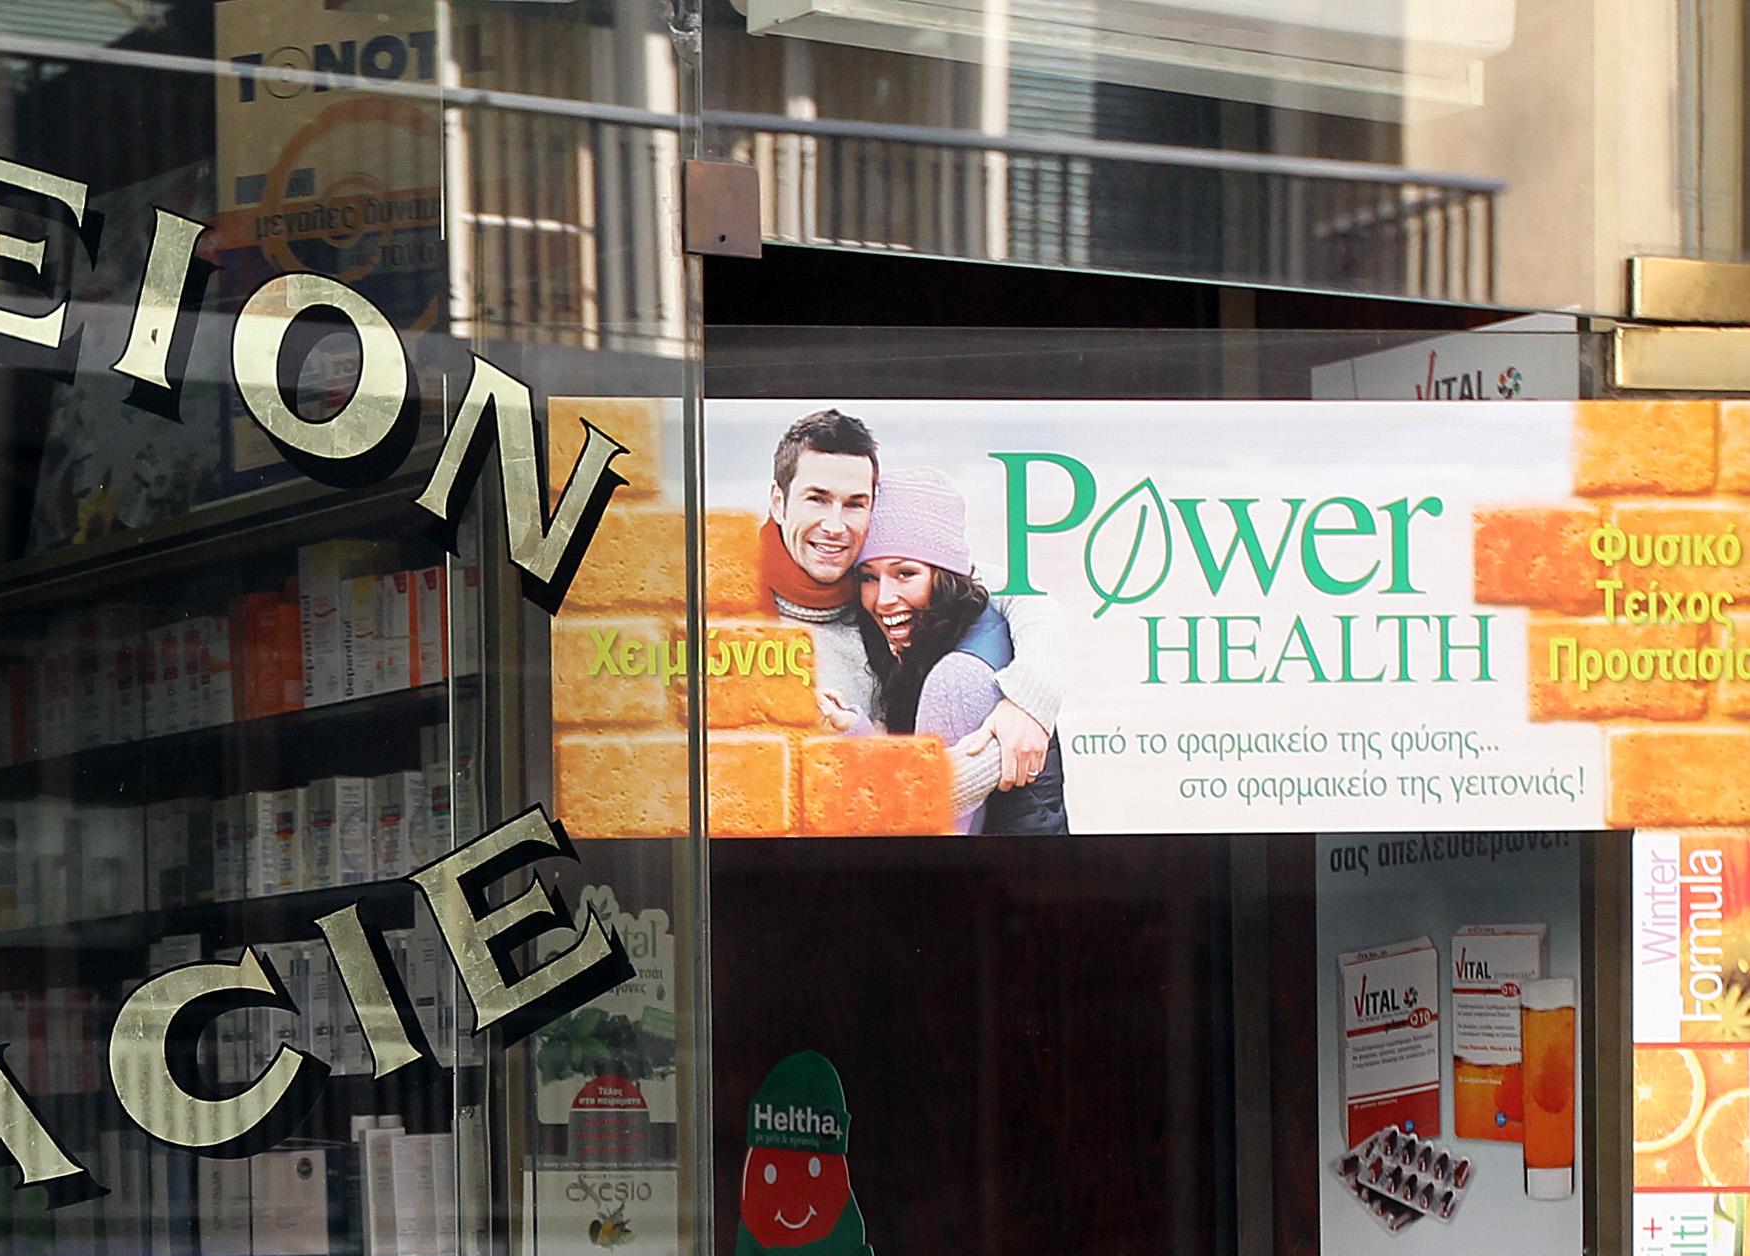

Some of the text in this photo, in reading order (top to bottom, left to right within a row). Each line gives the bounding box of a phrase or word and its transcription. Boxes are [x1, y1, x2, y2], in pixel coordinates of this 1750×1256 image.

[987, 451, 1444, 619] Power
[1589, 522, 1742, 567] Φυσικό
[1595, 579, 1736, 631] Τείχος
[1139, 614, 1498, 684] HEALTH
[1071, 728, 1127, 755] από
[1136, 733, 1168, 755] το
[1176, 726, 1328, 761] φαρμακείο
[1338, 731, 1382, 759] της
[1180, 766, 1586, 805] στο φαρμακείο της γειτονιάς!
[1330, 844, 1369, 876] σας
[1641, 850, 1677, 966] Winter
[1680, 849, 1723, 1021] Formula
[1456, 947, 1492, 979] VITAL
[1353, 974, 1400, 1017] VITAL
[1409, 1010, 1432, 1026] Q10
